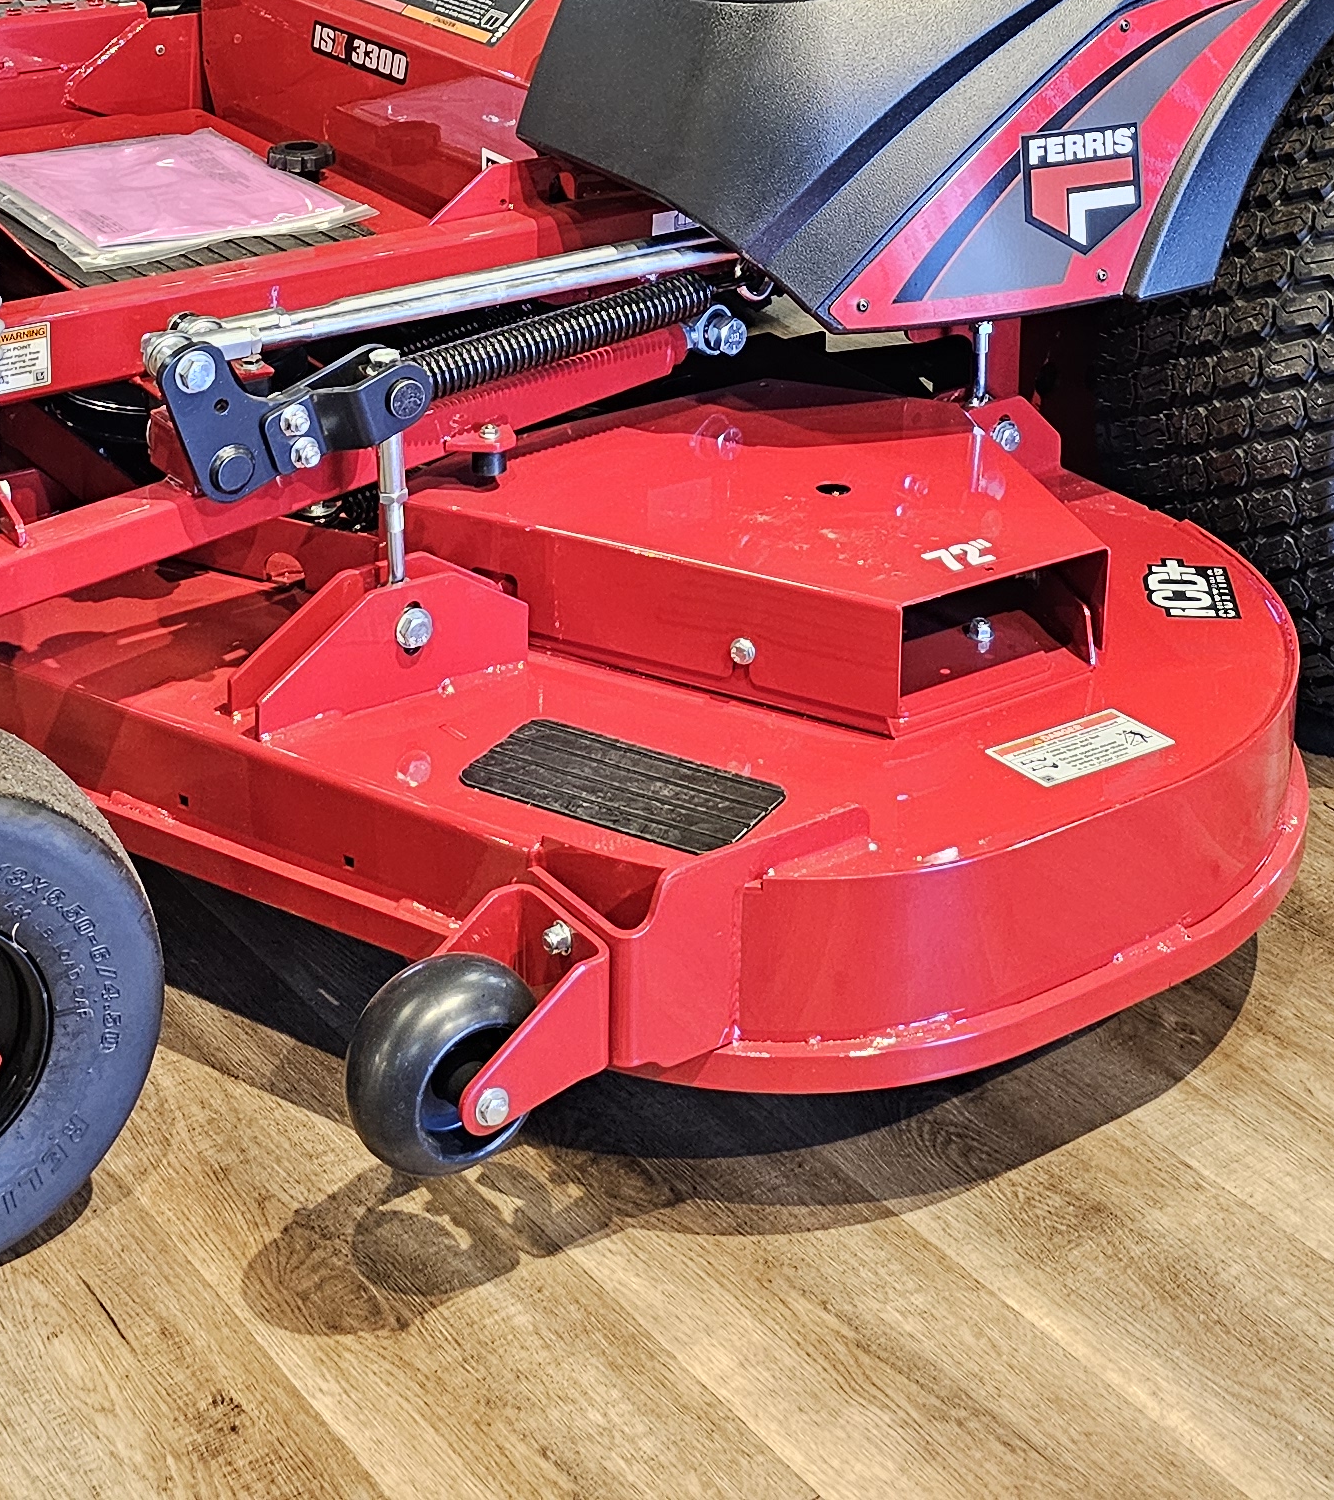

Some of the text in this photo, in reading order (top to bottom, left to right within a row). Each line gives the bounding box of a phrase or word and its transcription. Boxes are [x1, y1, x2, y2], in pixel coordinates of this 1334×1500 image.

[313, 24, 407, 80] ISX 3300
[1028, 127, 1135, 166] FERRIS
[1, 327, 45, 343] WARNING
